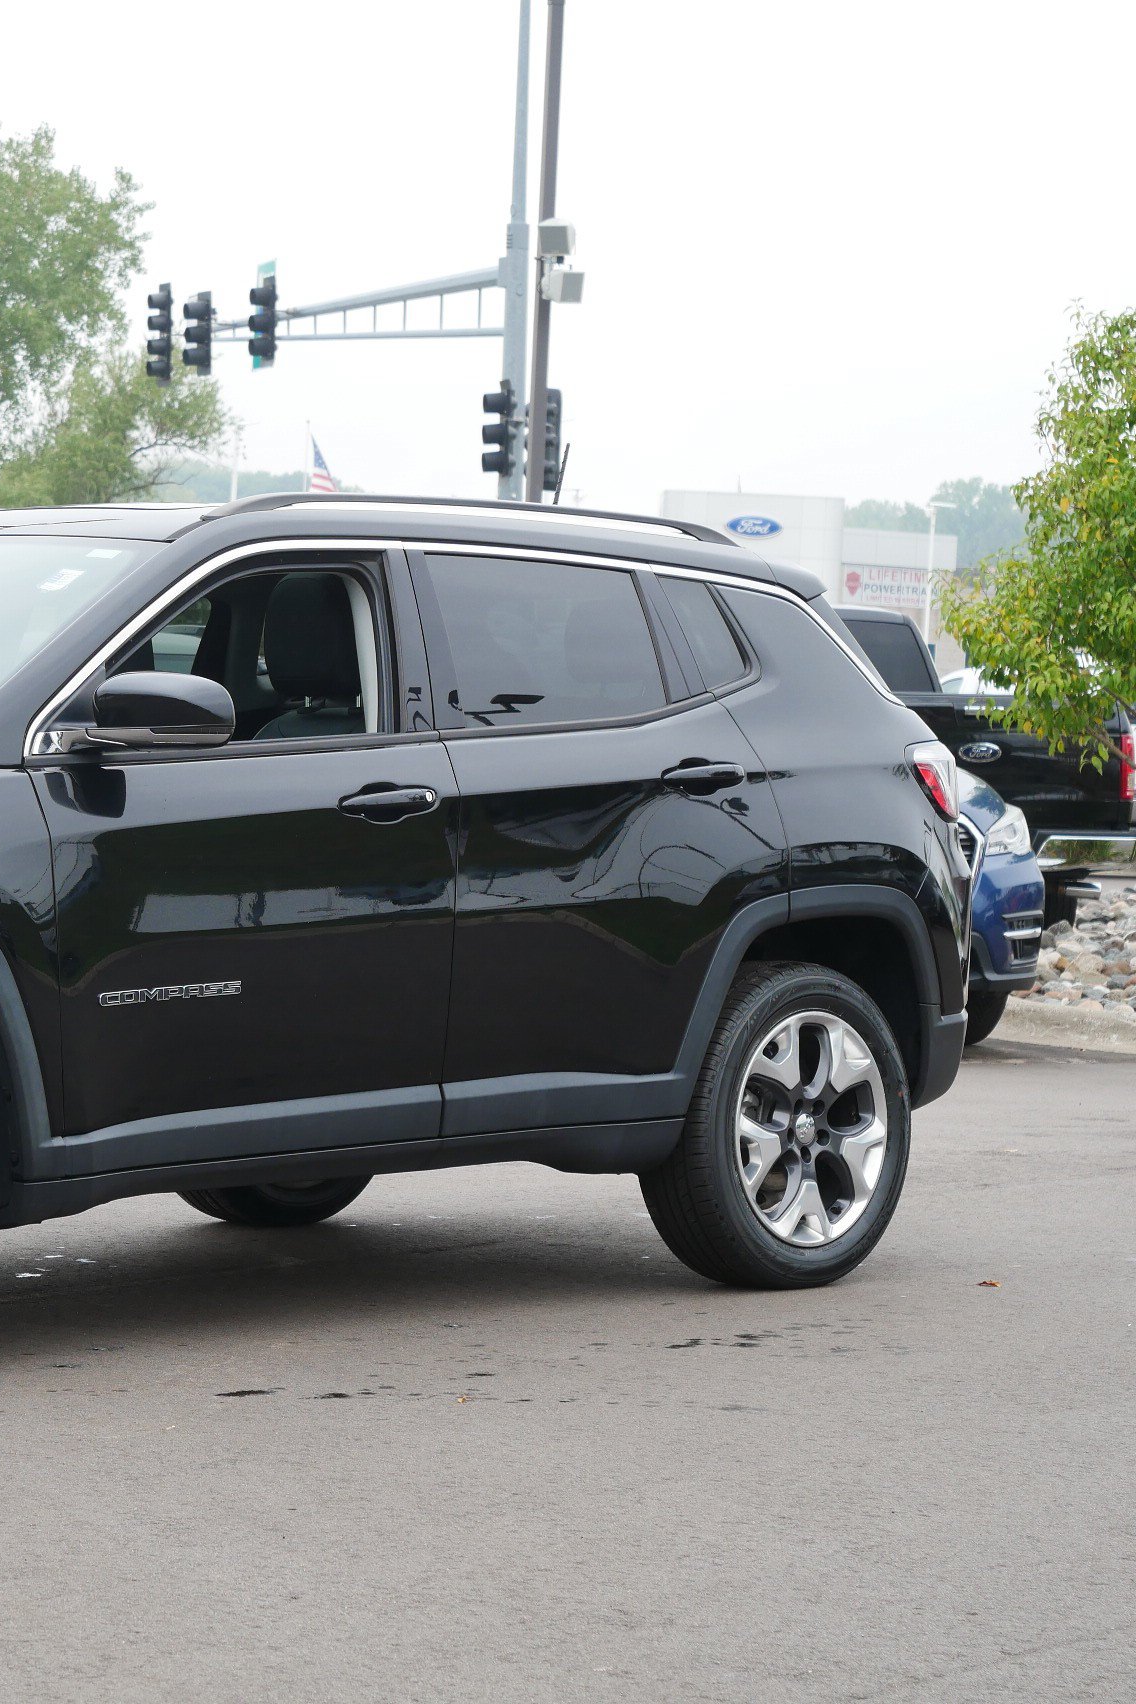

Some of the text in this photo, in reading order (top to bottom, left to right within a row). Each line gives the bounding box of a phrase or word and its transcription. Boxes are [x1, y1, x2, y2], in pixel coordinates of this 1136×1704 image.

[737, 519, 771, 534] Ford
[863, 583, 938, 596] POWERTRAN
[969, 746, 993, 758] Ford
[99, 980, 242, 1007] COMPASS
